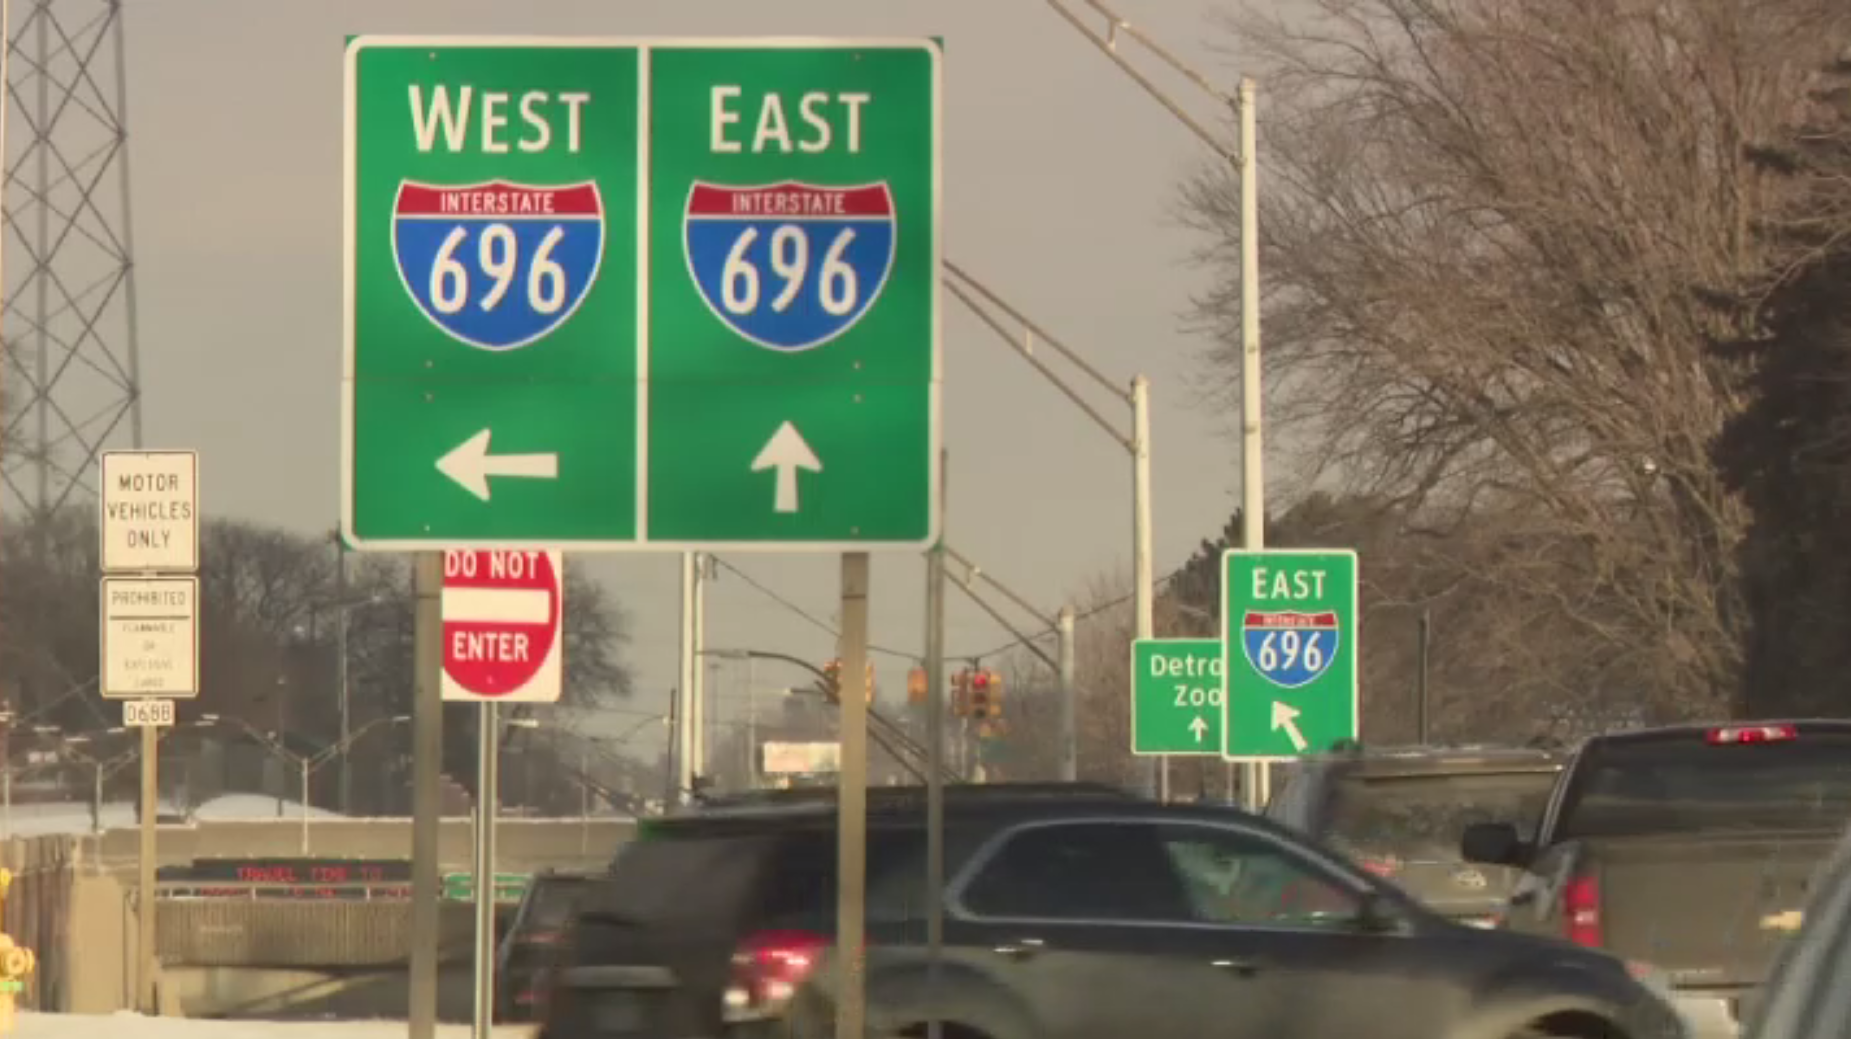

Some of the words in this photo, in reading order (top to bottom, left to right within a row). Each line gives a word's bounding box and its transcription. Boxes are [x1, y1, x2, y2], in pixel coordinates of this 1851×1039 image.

[409, 85, 590, 153] WEST
[711, 86, 870, 153] EAST
[440, 191, 555, 214] INTERSTATE
[732, 192, 846, 214] INTERSTATE
[429, 223, 566, 315] 696
[721, 224, 858, 316] 696
[119, 473, 178, 492] MOTOR
[107, 501, 191, 520] VEHICLES
[128, 530, 170, 548] ONLY
[445, 550, 477, 577] DO
[490, 550, 540, 579] NOT
[1251, 567, 1326, 599] EAST
[111, 591, 186, 606] PROHIBITED
[453, 631, 529, 662] ENTER
[1258, 630, 1322, 671] 696
[1174, 684, 1223, 707] Zoo
